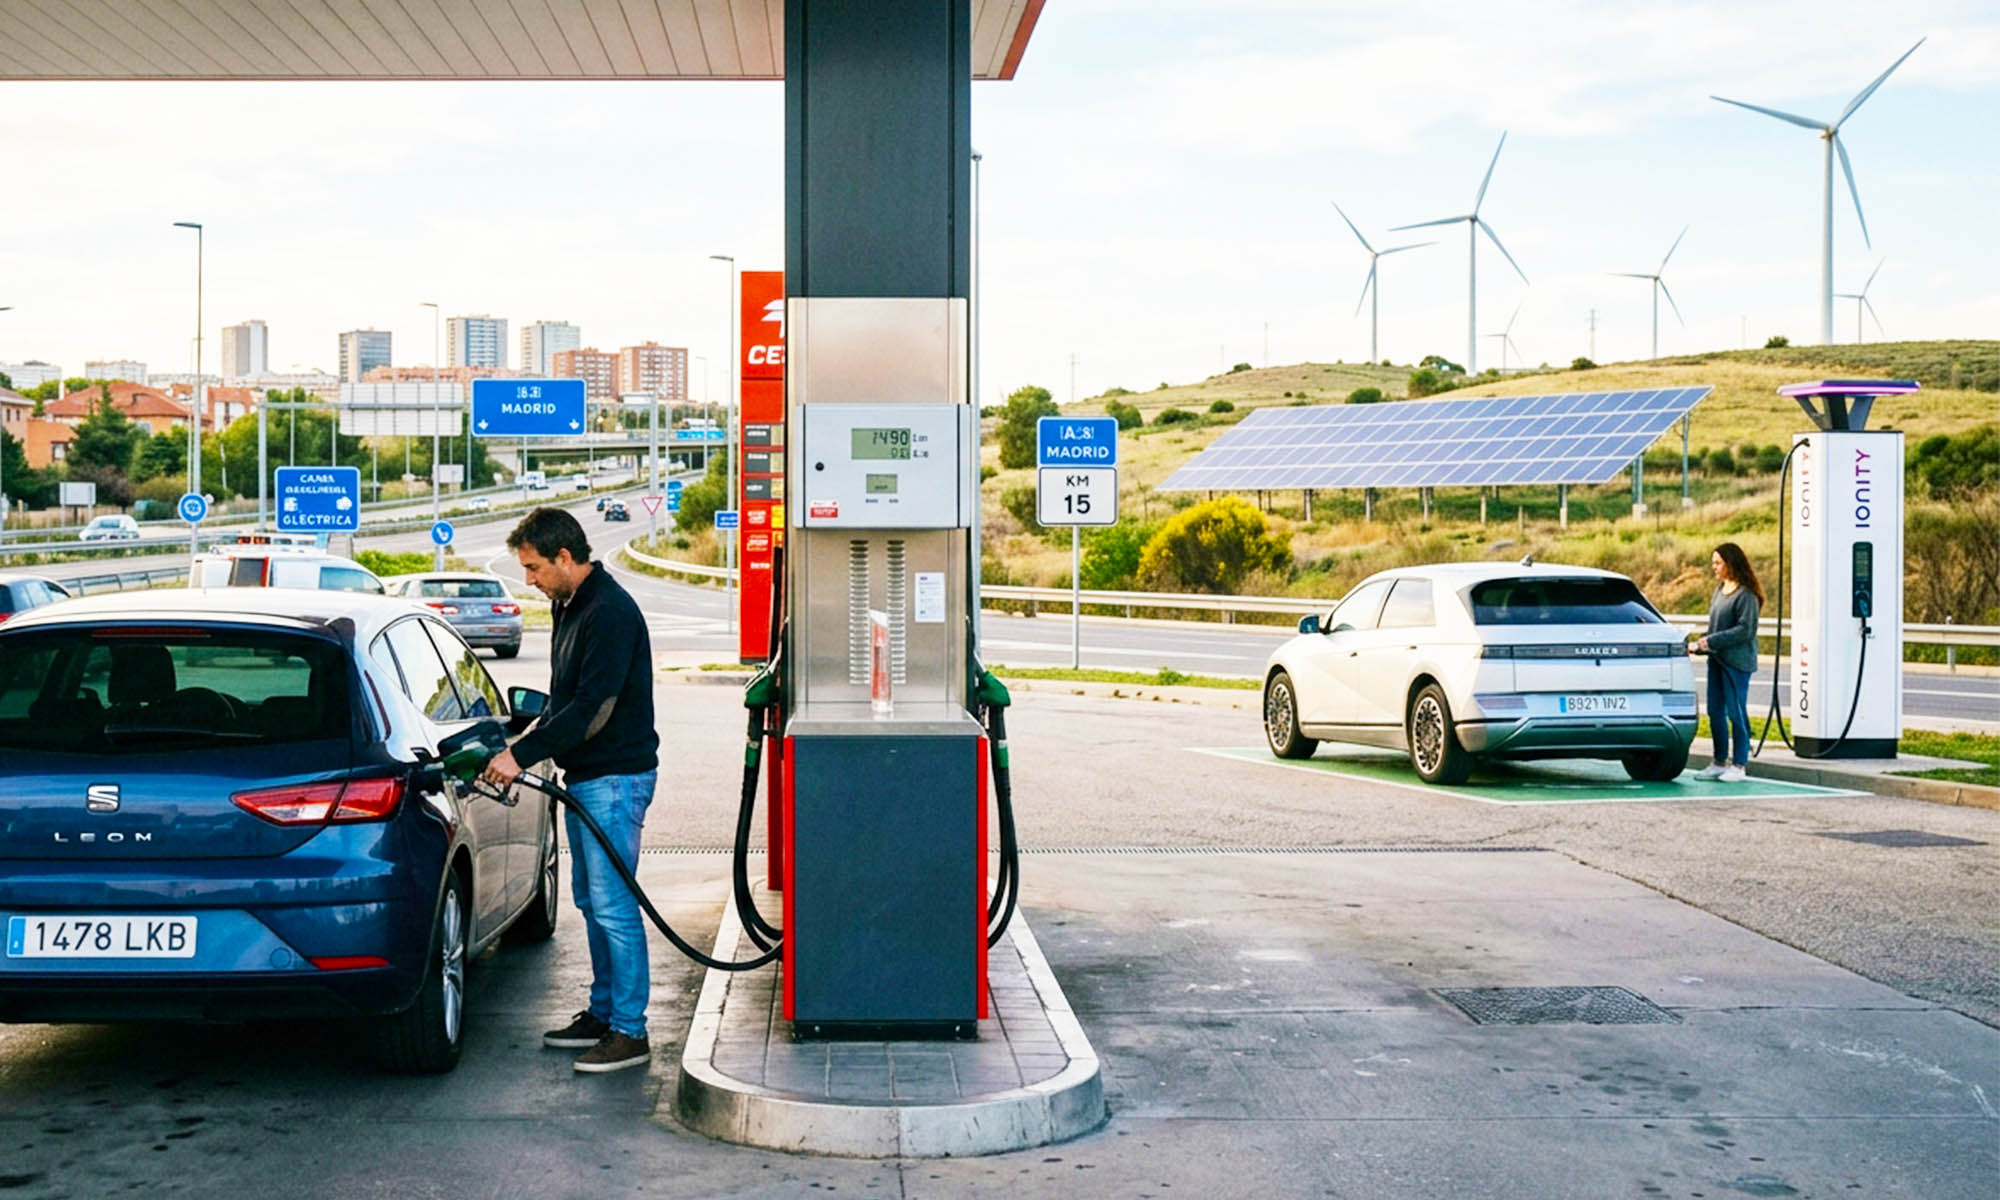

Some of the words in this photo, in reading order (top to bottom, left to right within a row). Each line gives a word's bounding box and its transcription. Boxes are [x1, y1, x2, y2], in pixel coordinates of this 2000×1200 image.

[501, 403, 556, 414] MADRID
[1046, 446, 1109, 459] MADRID
[1066, 475, 1089, 487] KM
[1855, 448, 1871, 528] IONITY
[1064, 494, 1091, 515] 15
[36, 922, 112, 951] 1478
[125, 922, 186, 951] LKB
